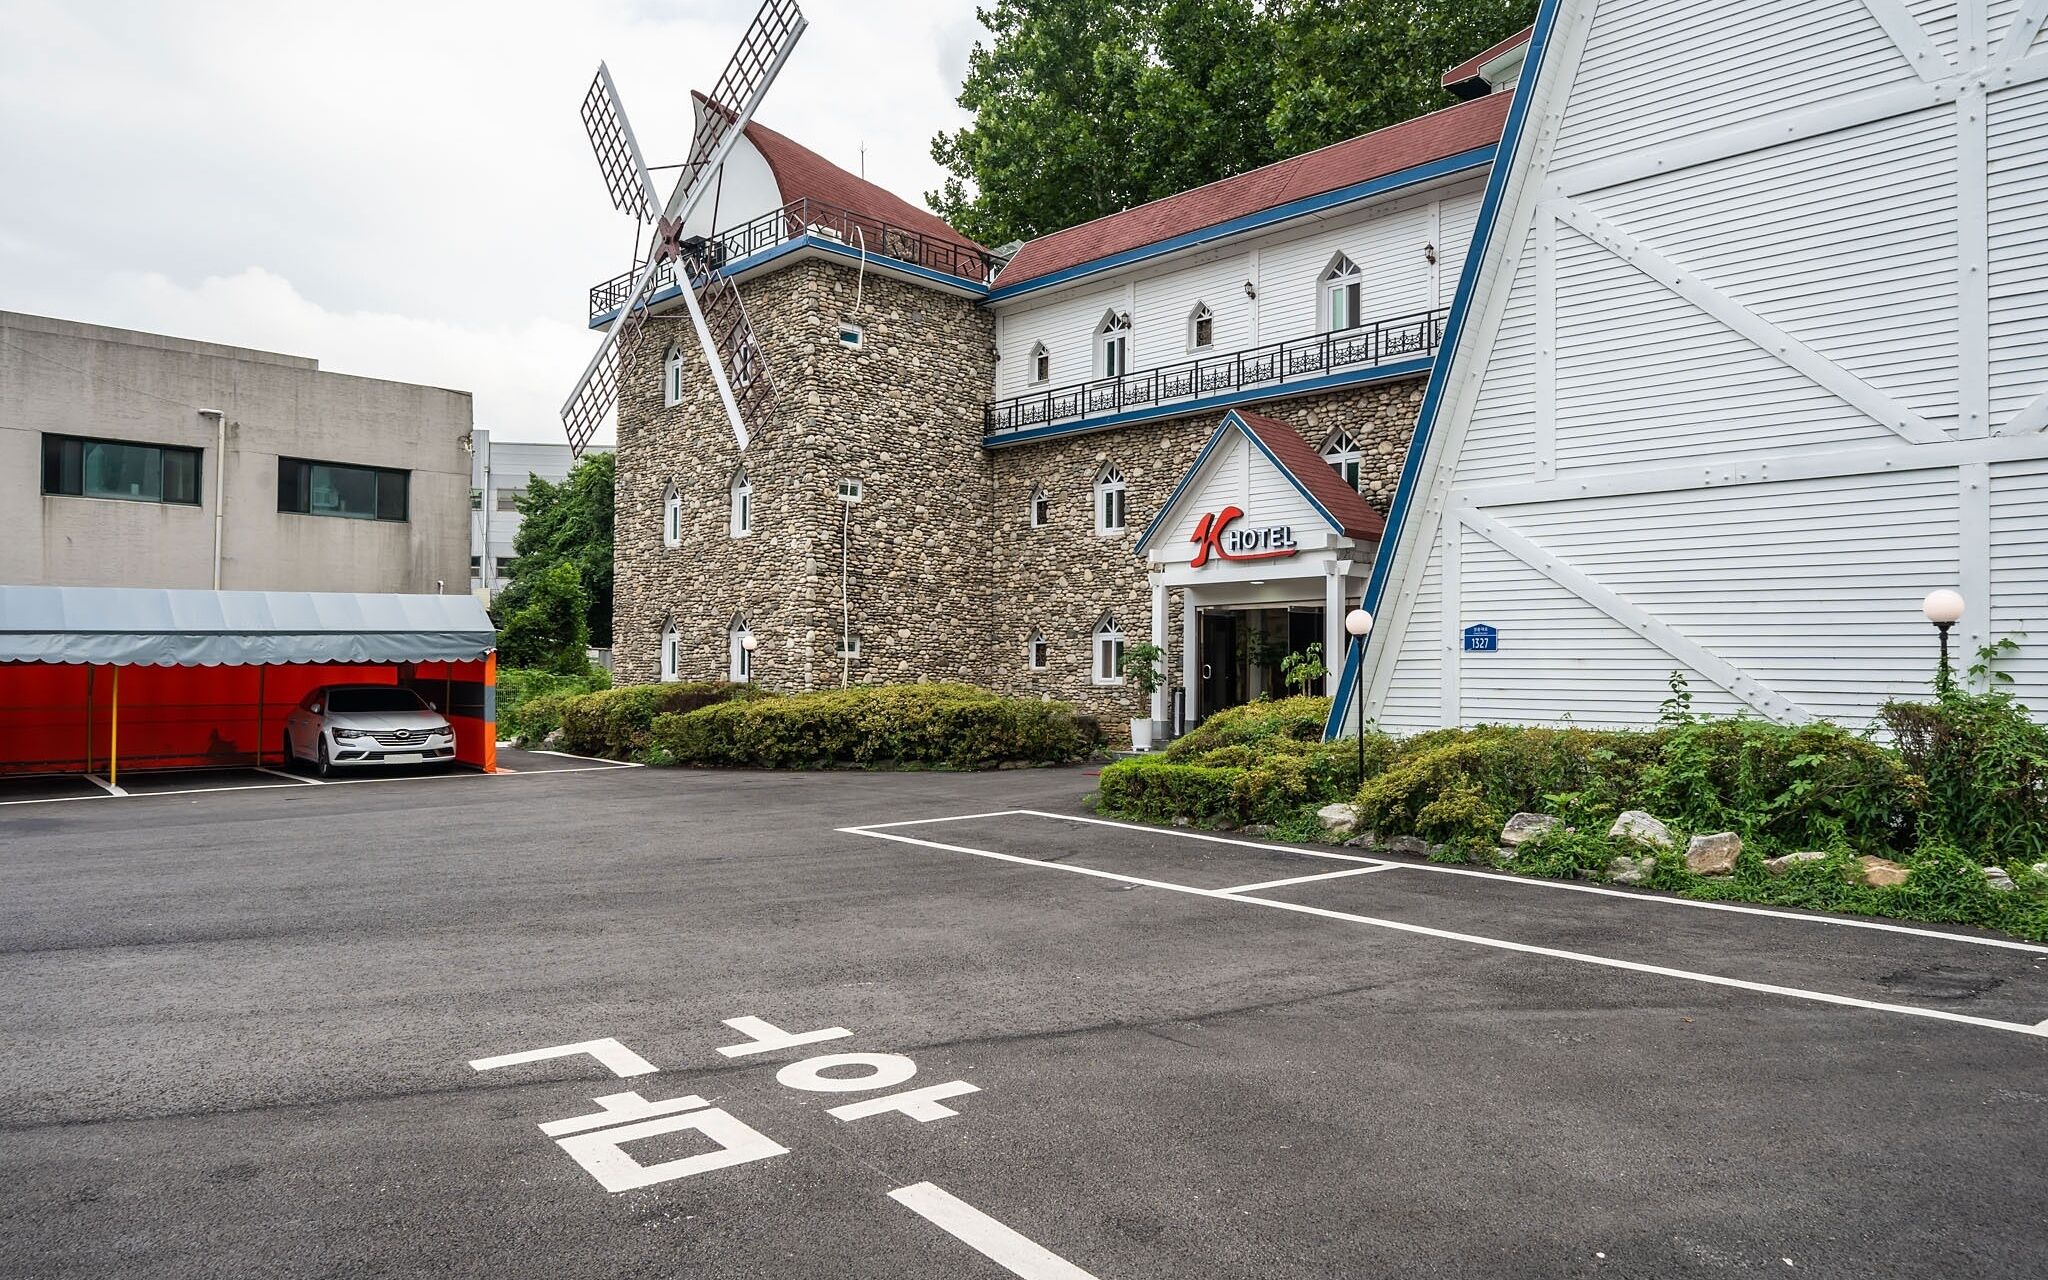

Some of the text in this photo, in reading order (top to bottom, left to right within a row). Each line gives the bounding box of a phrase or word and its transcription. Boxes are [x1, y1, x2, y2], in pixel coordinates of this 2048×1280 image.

[1190, 506, 1297, 568] K HOTEL
[1471, 637, 1489, 649] 1327
